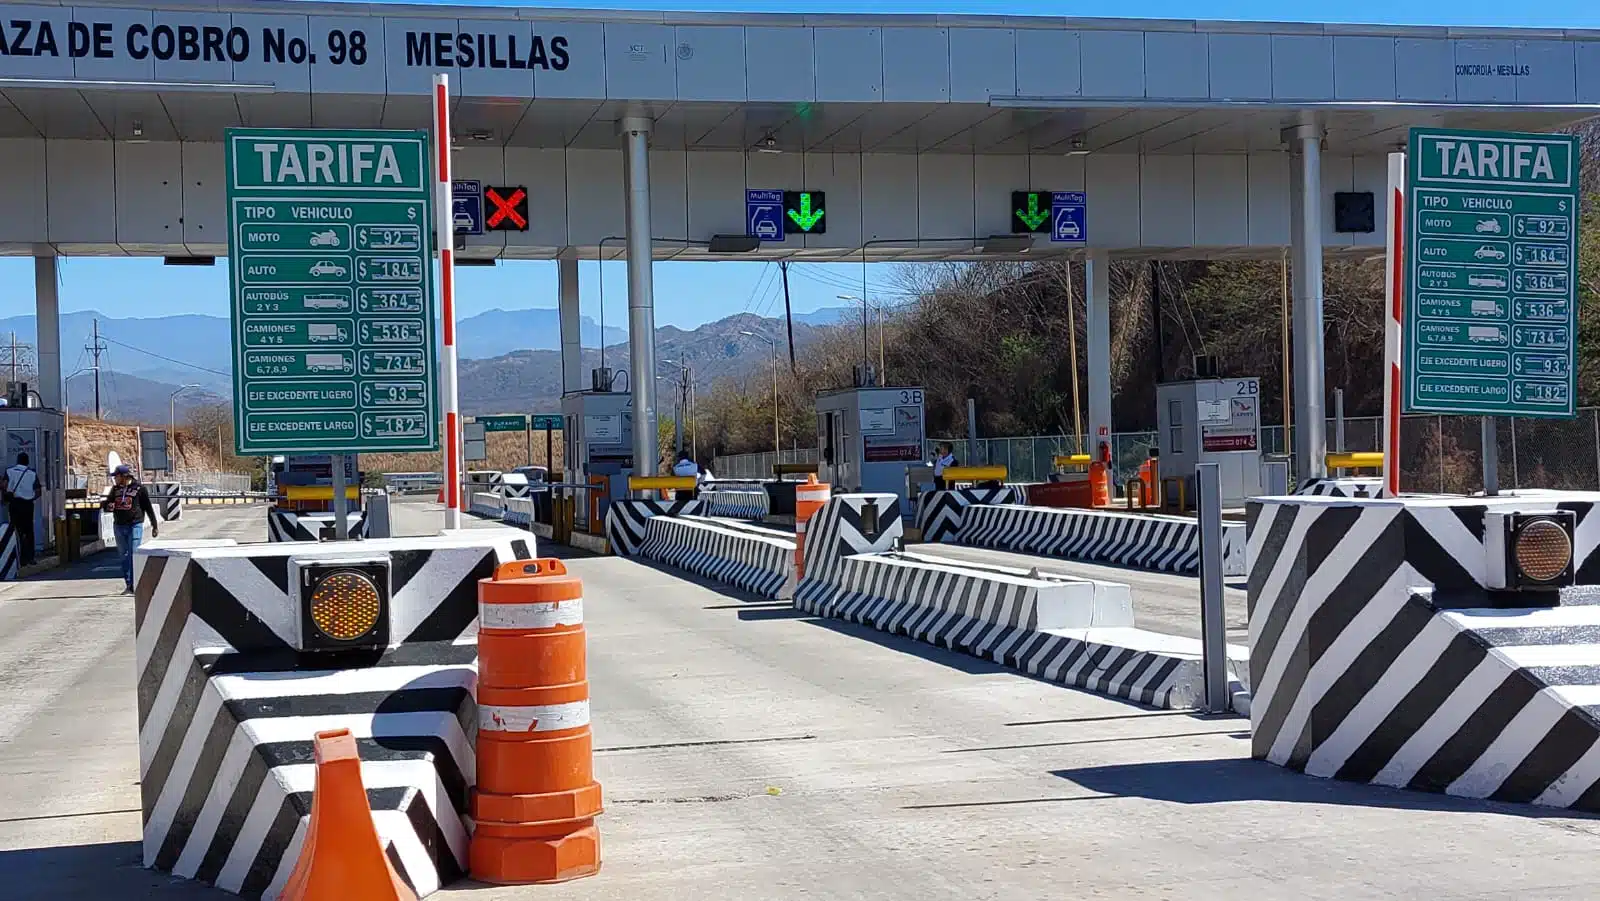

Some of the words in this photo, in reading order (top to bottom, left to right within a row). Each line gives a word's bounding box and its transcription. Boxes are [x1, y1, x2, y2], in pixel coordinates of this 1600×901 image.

[69, 23, 113, 58] DE
[126, 24, 249, 62] COBRO
[263, 28, 316, 64] No.
[328, 29, 367, 65] 98
[406, 31, 569, 71] MESILLAS
[254, 143, 403, 184] TARIFA
[1436, 141, 1554, 180] TARIFA
[750, 192, 780, 201] MultiTag
[1055, 194, 1083, 203] MultiTag
[1423, 196, 1448, 207] TIPO
[1462, 197, 1513, 210] VEHICULO
[1558, 200, 1567, 212] $
[244, 206, 276, 219] TIPO
[291, 207, 353, 219] VEHICULO
[407, 207, 416, 220] $
[1425, 219, 1452, 228] MOTO
[1517, 219, 1525, 234] $
[1538, 220, 1555, 234] 92
[248, 232, 280, 243] MOTO
[359, 229, 368, 246] $
[383, 231, 402, 245] 92
[1423, 247, 1448, 256] AUTO
[1516, 247, 1523, 262] $
[1532, 250, 1556, 263] 184
[247, 265, 277, 275] AUTO
[359, 262, 367, 278] $
[382, 263, 410, 277] 184
[1436, 280, 1443, 288] Y
[1443, 280, 1449, 288] 3
[1515, 276, 1523, 290] $
[1530, 276, 1555, 289] 364
[257, 303, 263, 311] 2
[265, 303, 271, 311] Y
[273, 303, 279, 311] 3
[360, 293, 369, 309] $
[379, 295, 408, 307] 364
[1420, 299, 1461, 307] CAMIONES
[1515, 302, 1522, 317] $
[1530, 303, 1554, 318] 536
[246, 324, 296, 334] CAMIONES
[361, 323, 369, 340] $
[382, 325, 409, 340] 536
[1420, 325, 1460, 334] CAMIONES
[1516, 329, 1523, 345] $
[1531, 331, 1556, 345] 734
[260, 336, 267, 344] 4
[269, 336, 275, 344] Y
[277, 336, 283, 344] 5
[248, 354, 296, 364] CAMIONES
[362, 354, 370, 371] $
[385, 356, 412, 370] 734
[256, 366, 288, 375] 6,7,8,9
[1420, 357, 1433, 365] EJE
[1435, 358, 1478, 367] EXCEDENTE
[1480, 360, 1507, 368] LIGERO
[1515, 357, 1522, 373] $
[1544, 359, 1561, 374] 93
[249, 391, 264, 401] EJE
[267, 391, 318, 400] EXCEDENTE
[320, 390, 353, 400] LIGERO
[363, 386, 371, 403] $
[389, 387, 407, 401] 93
[1420, 384, 1433, 392] EJE
[1434, 384, 1479, 394] EXCEDENTE
[1481, 386, 1507, 395] LARGO
[1514, 385, 1522, 400] $
[1536, 386, 1560, 400] 182
[250, 422, 266, 432] EJE
[268, 421, 321, 431] EXCEDENTE
[323, 420, 354, 430] LARGO
[364, 417, 373, 434] $
[386, 419, 415, 432] 182
